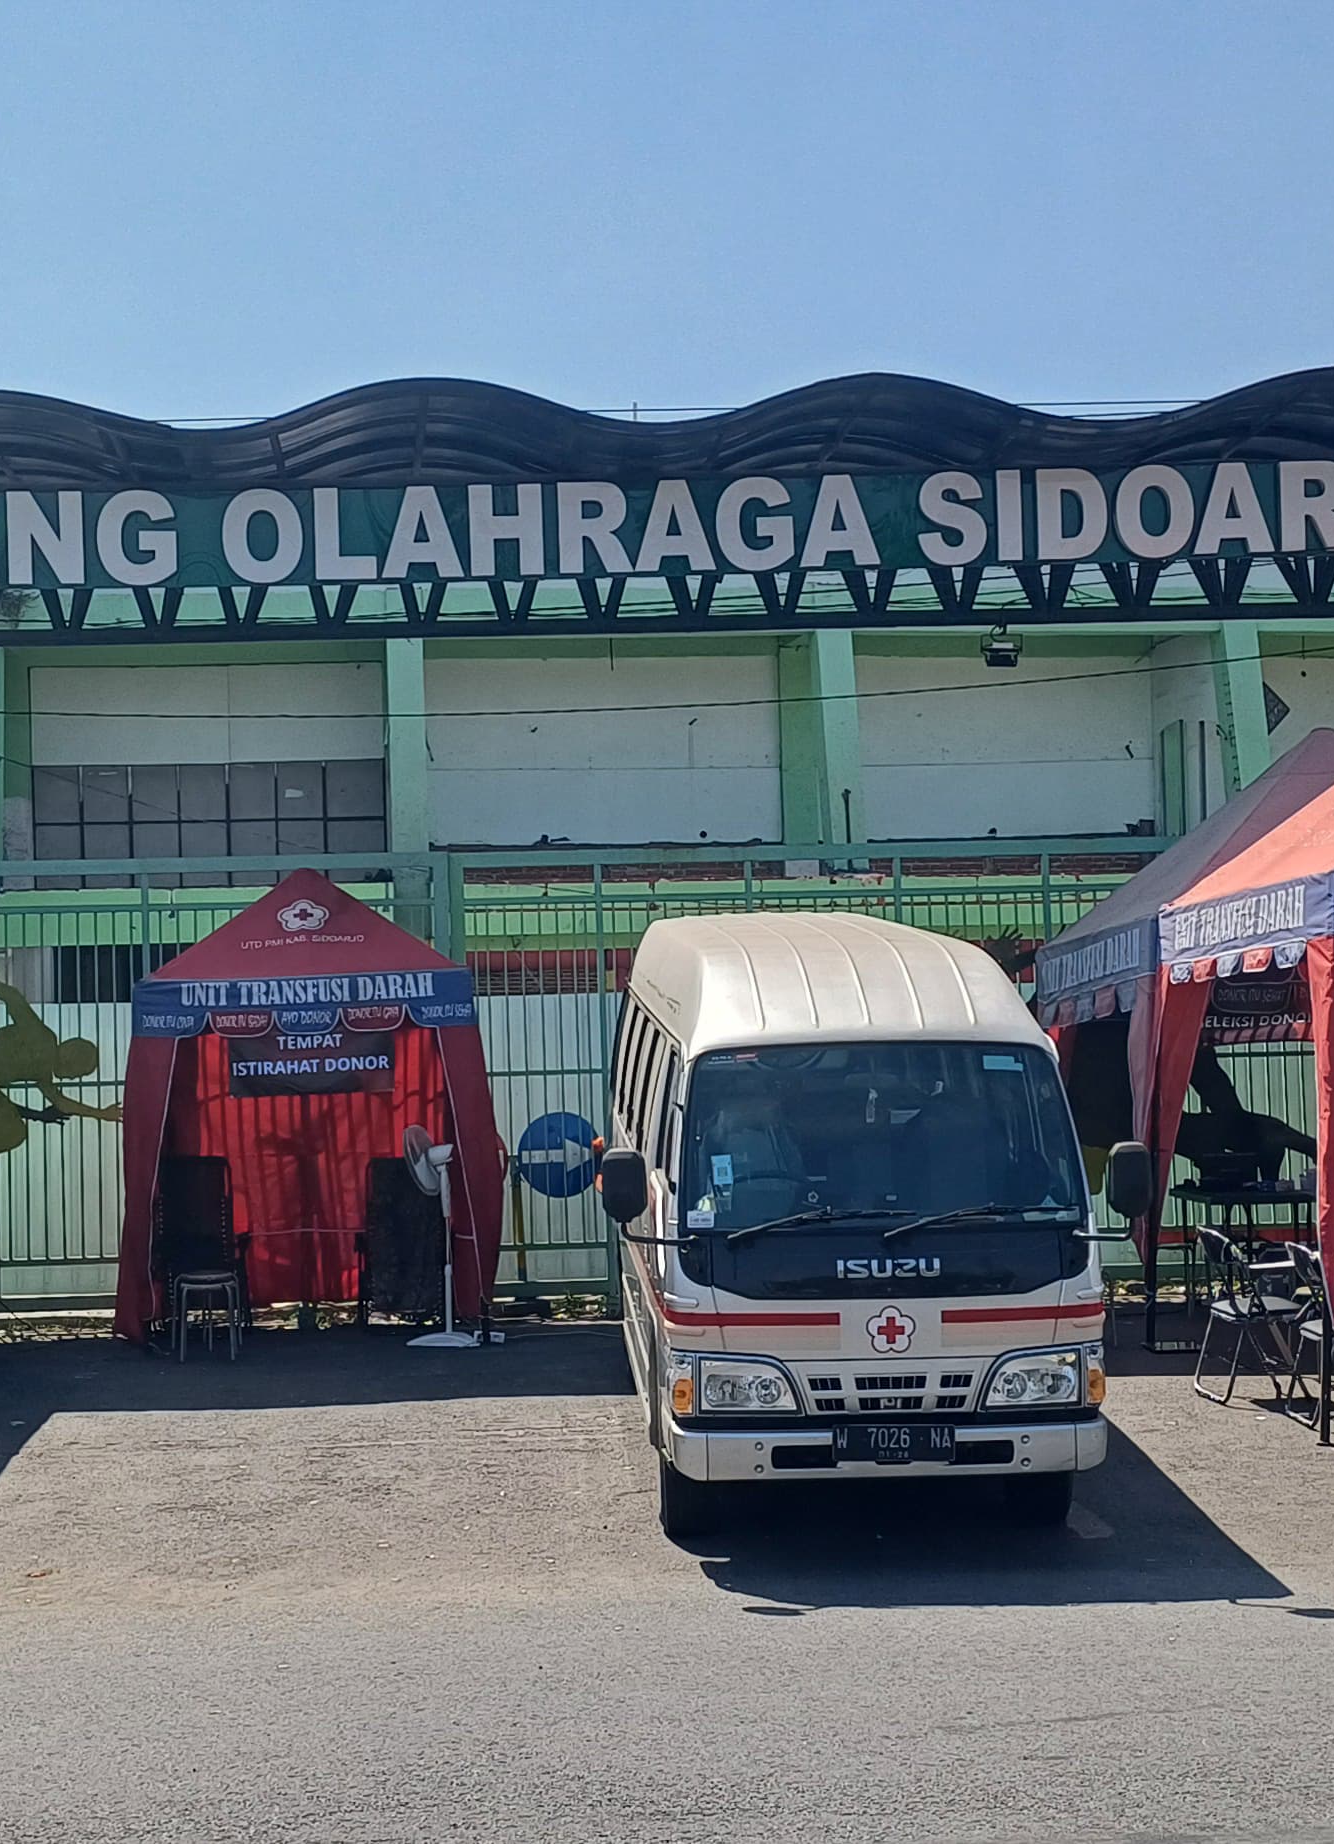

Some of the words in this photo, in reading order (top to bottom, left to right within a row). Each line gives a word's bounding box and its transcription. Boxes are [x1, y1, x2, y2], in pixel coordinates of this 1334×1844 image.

[222, 472, 885, 582] OLAHRAGA
[1257, 885, 1305, 935] DARAH
[241, 941, 262, 949] UTD
[265, 939, 283, 947] PMI
[180, 982, 229, 1006] UNIT
[237, 977, 351, 1006] TRANSFUSI
[357, 972, 435, 1001] DARAH
[300, 1010, 332, 1025] DONOR
[1202, 1015, 1254, 1028] ELEKSI
[276, 1034, 343, 1050] TEMPAT
[232, 1059, 320, 1076] ISTIRAHAT
[325, 1056, 389, 1072] DONOR
[837, 1258, 940, 1278] ISUZU
[836, 1428, 848, 1448] W
[868, 1428, 910, 1448] 7026
[931, 1428, 951, 1448] NA
